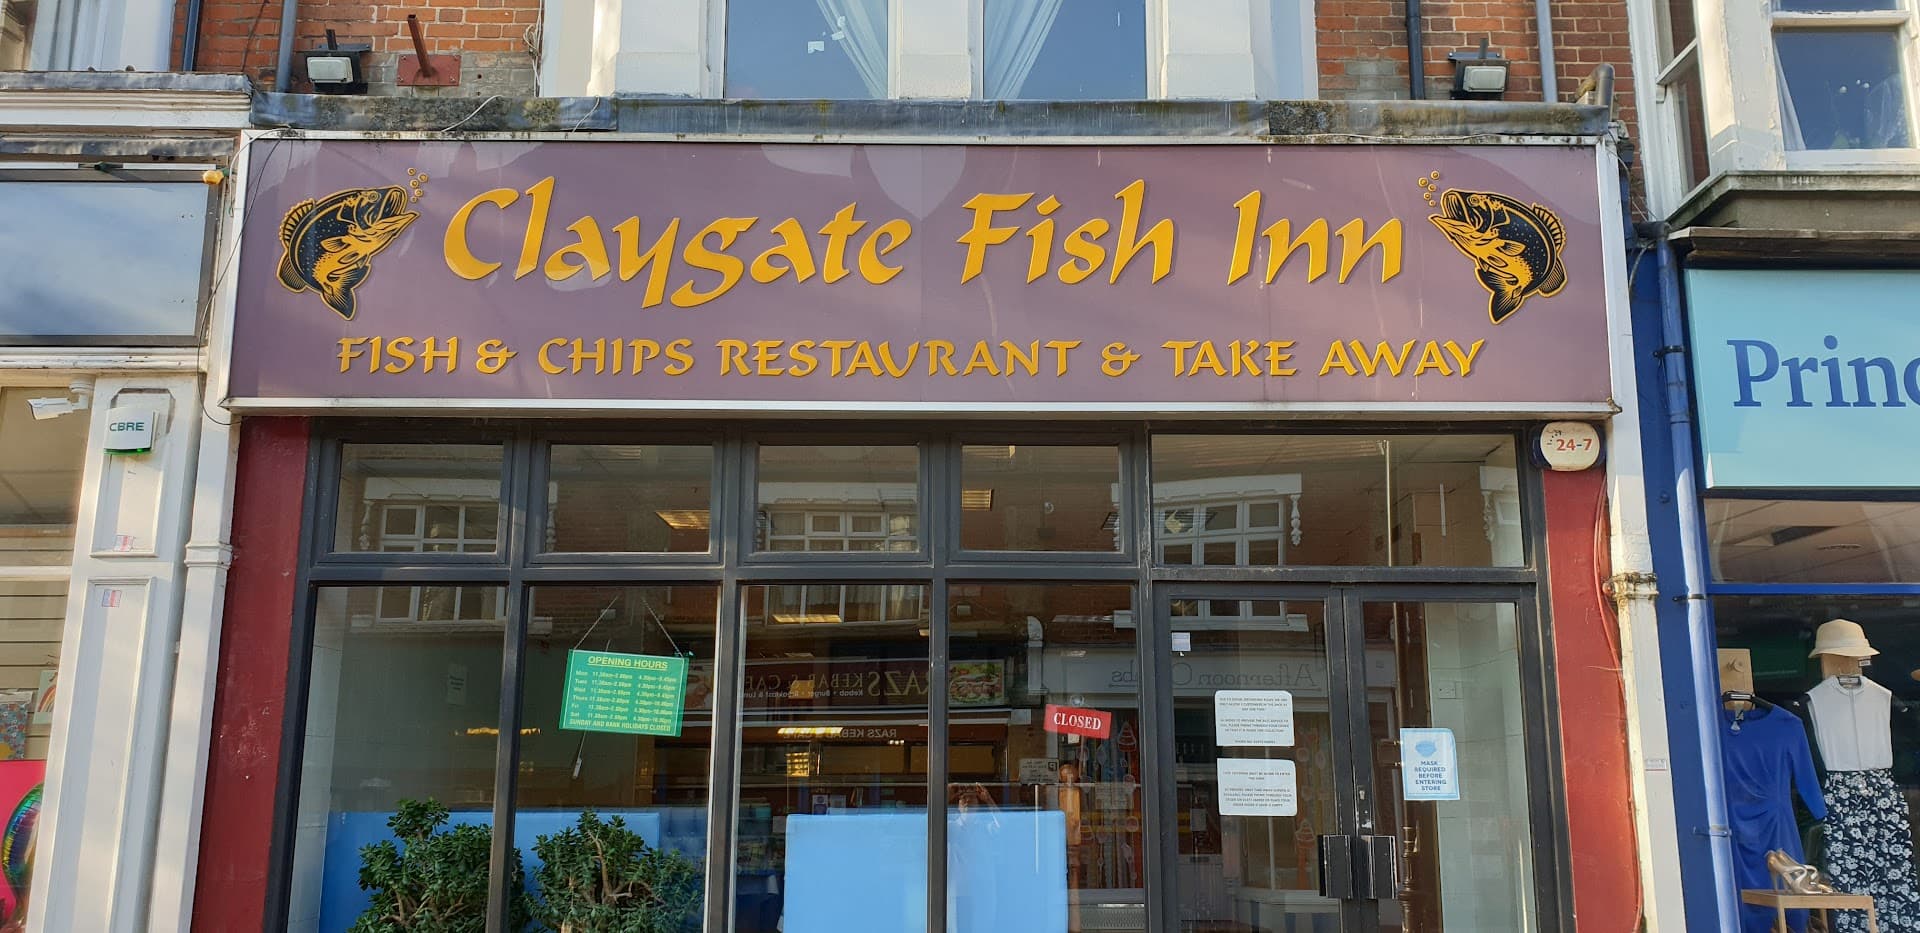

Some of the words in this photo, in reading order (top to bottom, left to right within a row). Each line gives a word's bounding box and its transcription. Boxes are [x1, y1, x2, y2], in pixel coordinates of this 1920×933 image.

[444, 176, 913, 309] Claygate
[956, 179, 1174, 284] Fish
[1227, 190, 1402, 285] Inn
[336, 335, 459, 374] FISH
[476, 338, 518, 375] &
[537, 338, 695, 376] CHIPS
[715, 338, 1082, 378] RESTAURANT
[1100, 341, 1142, 377] &
[1160, 339, 1299, 378] TAKE
[1318, 338, 1486, 378] AWAY
[109, 421, 145, 432] CBRE
[1556, 438, 1593, 451] 24-7
[588, 655, 631, 668] OPENING
[634, 658, 668, 670] HOURS
[1053, 712, 1102, 730] CLOSED
